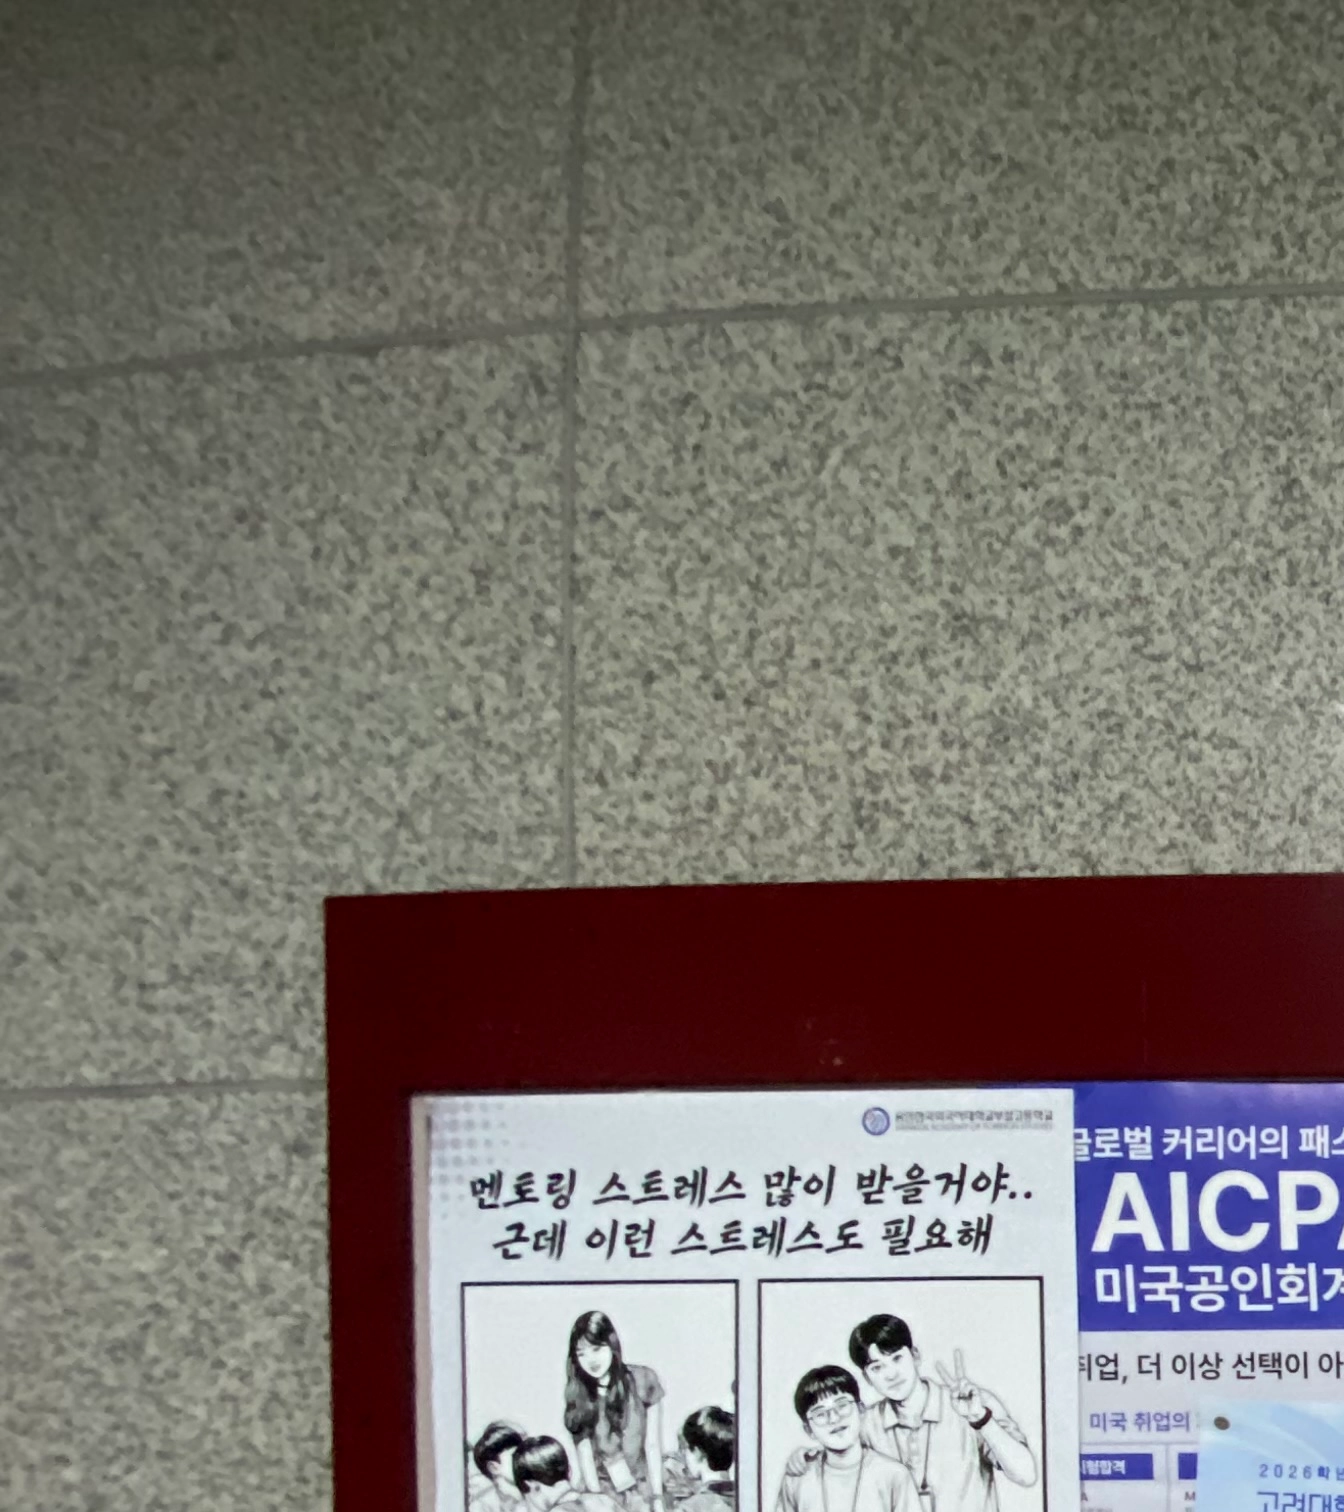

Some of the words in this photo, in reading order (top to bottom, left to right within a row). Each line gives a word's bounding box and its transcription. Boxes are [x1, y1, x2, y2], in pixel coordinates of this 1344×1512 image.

[1162, 1126, 1288, 1159] 커리어의
[470, 1168, 578, 1210] 멘토링
[591, 1166, 748, 1207] 스트레스
[764, 1164, 836, 1207] 많이
[855, 1161, 1033, 1206] 받을거야..
[492, 1219, 566, 1259] 근데
[586, 1219, 656, 1258] 이런
[671, 1217, 864, 1258] 스트레스도
[881, 1215, 993, 1256] 필요해
[1137, 1355, 1161, 1381] 더
[1171, 1353, 1222, 1380] 이상
[1231, 1352, 1309, 1380] 선택이
[1090, 1412, 1127, 1432] 미국
[1133, 1411, 1190, 1432] 취업의
